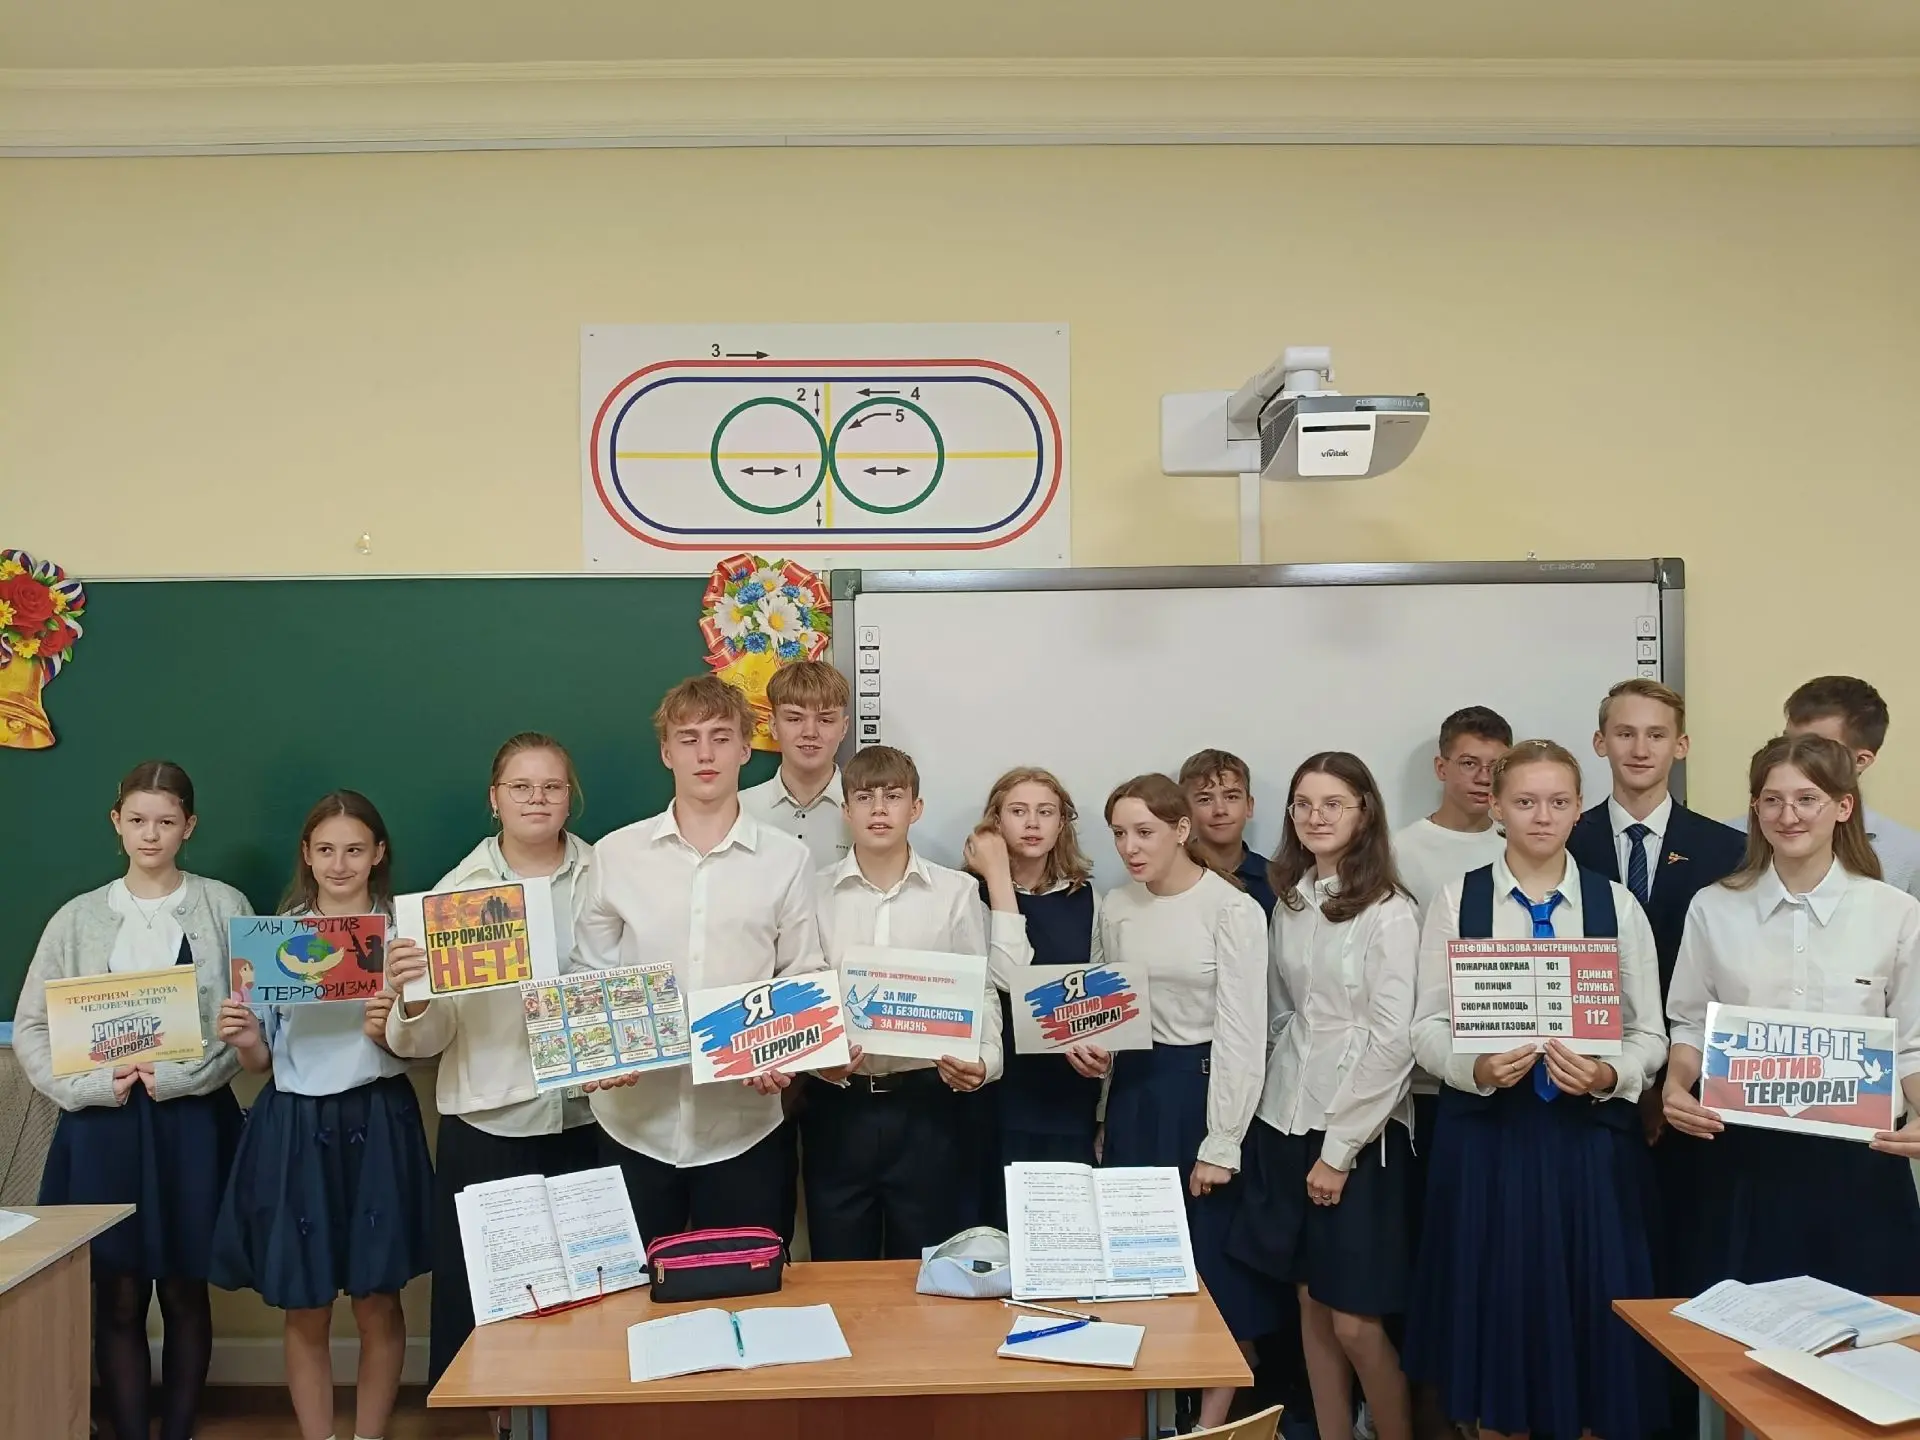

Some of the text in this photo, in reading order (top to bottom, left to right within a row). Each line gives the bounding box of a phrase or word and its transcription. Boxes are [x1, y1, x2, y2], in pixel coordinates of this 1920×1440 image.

[711, 343, 721, 358] 3
[796, 387, 806, 402] 2
[910, 386, 921, 401] 4
[895, 408, 905, 423] 5
[1321, 449, 1348, 458] vivitek
[794, 463, 802, 478] 1
[244, 916, 361, 937] МЫ ПРОТИВ
[1450, 943, 1617, 953] ТЕЛЕФОНЫ ВЫЗОВА ЭКСТРЕННЫХ СЛУЖБ
[432, 938, 527, 986] НЕТ!
[1456, 962, 1559, 971] ПОЖАРНАЯ ОХРАНА 101
[1577, 970, 1613, 980] ЕДИНАЯ
[65, 990, 129, 1004] ТЕРРОРИЗМ
[139, 986, 178, 997] УГРОЗА
[258, 980, 377, 1001] ТЕРРОРИЗМА
[1063, 970, 1088, 1003] Я
[1474, 982, 1561, 991] ПОЛИЦИЯ 102
[1577, 983, 1615, 992] СЛУЖБА
[883, 990, 917, 1002] ЗА МИР
[1573, 995, 1620, 1005] СПАСЕНИЯ
[743, 984, 775, 1026] Я
[881, 1004, 964, 1022] ЗА БЕЗОПАСНОСТЬ
[1055, 997, 1100, 1021] ПРОТИВ
[1461, 1002, 1562, 1012] СКОРАЯ ПОМОЩЬ 103
[880, 1018, 928, 1032] ЗА ЖИЗНЬ
[1070, 1008, 1121, 1033] ТЕРРОРА!
[1456, 1020, 1562, 1031] АВАРИЙНАЯ ГАЗОВАЯ 104
[1584, 1009, 1609, 1025] 112
[93, 1016, 154, 1042] РОССИЯ
[732, 1014, 793, 1053] ПРОТИВ
[94, 1032, 136, 1053] ПРОТИВ
[104, 1036, 154, 1060] ТЕРРОРА!
[753, 1025, 820, 1065] ТЕРРОРА!
[1747, 1021, 1866, 1061] ВМЕСТЕ
[1730, 1056, 1823, 1081] ПРОТИВ
[1746, 1080, 1856, 1104] ТЕРРОРА!
